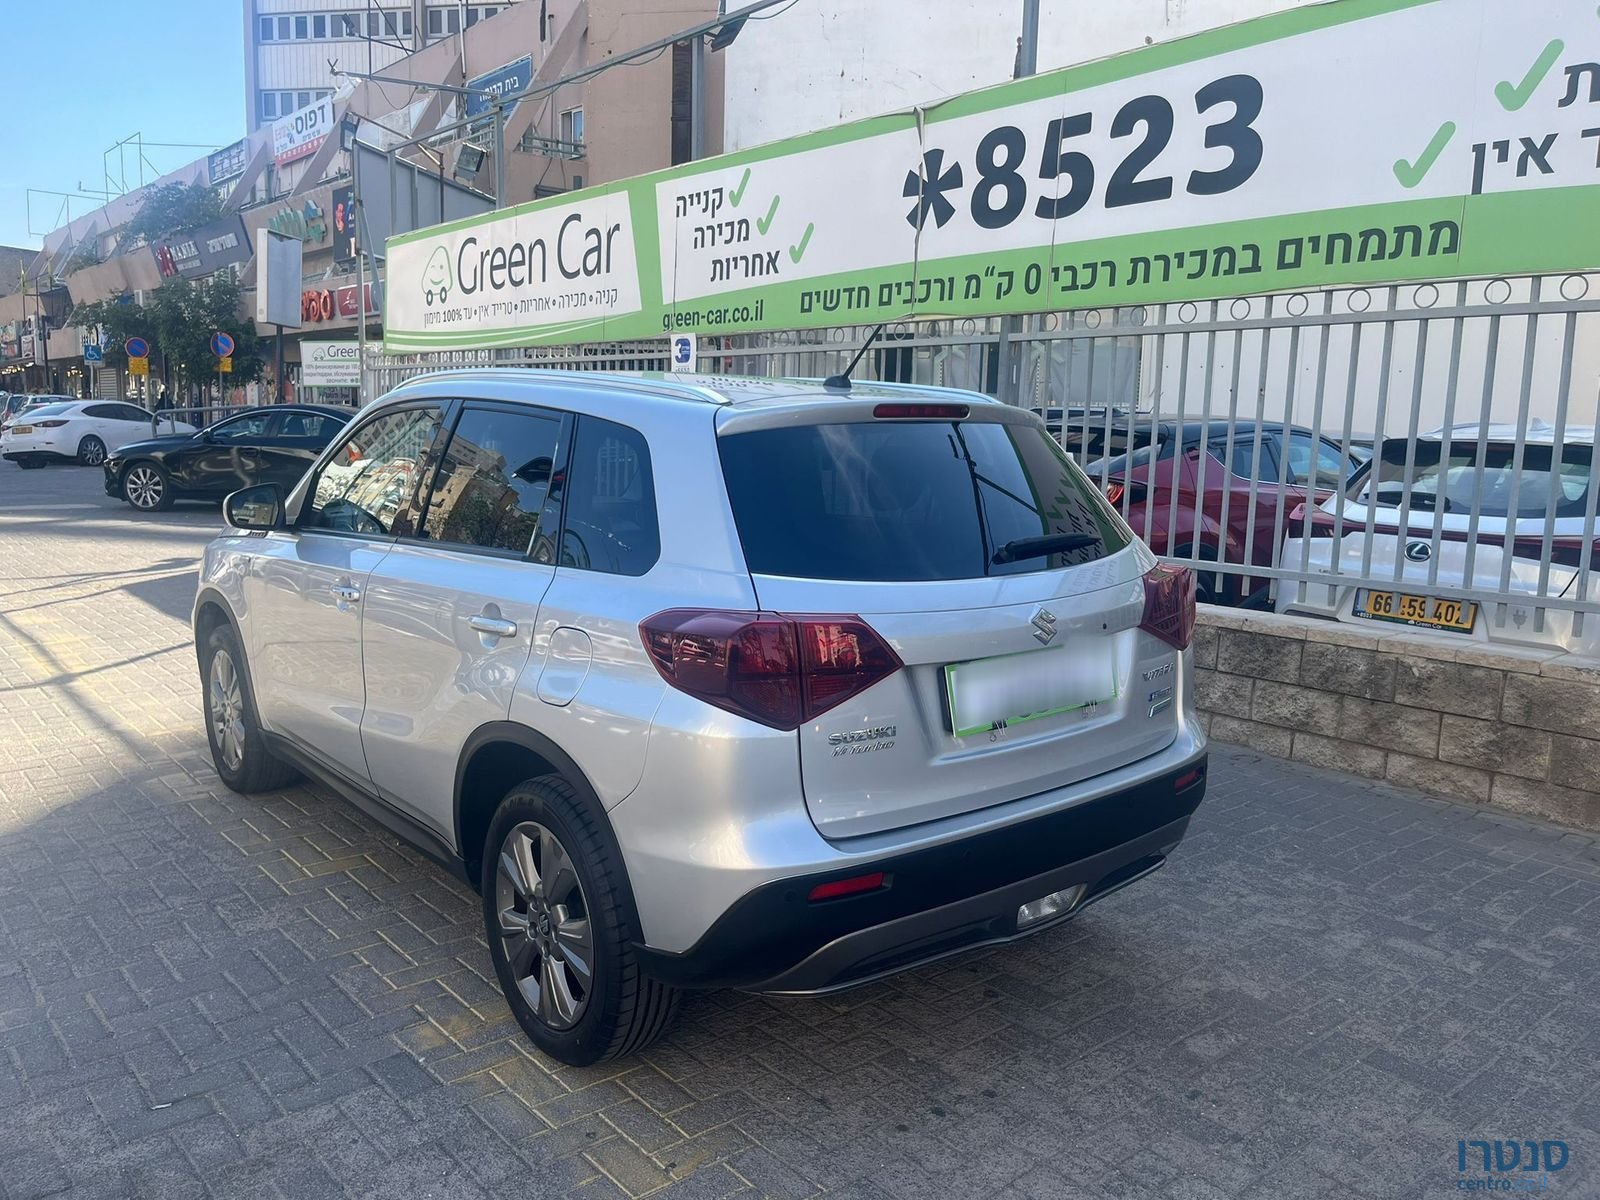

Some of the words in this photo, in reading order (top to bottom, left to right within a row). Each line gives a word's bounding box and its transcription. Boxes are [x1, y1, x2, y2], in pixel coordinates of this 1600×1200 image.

[295, 104, 325, 134] דפוס
[1471, 132, 1560, 195] אין
[676, 187, 724, 218] קנייה
[693, 218, 750, 249] מכירה
[1276, 220, 1460, 270] מתמחים
[457, 237, 546, 295] Green
[557, 213, 620, 279] Car
[710, 250, 780, 282] אחריות
[1126, 243, 1262, 286] במכירת
[878, 276, 955, 307] ורכבים
[1024, 263, 1042, 295] 0
[1051, 260, 1117, 292] רכבי
[519, 296, 551, 314] אחריות
[558, 292, 587, 309] מכירה
[596, 288, 618, 308] קניה
[800, 286, 871, 314] חדשים
[443, 308, 462, 323] 100%
[663, 299, 763, 331] green-car.co.il
[327, 344, 361, 358] Green
[828, 725, 896, 745] SUZUKI
